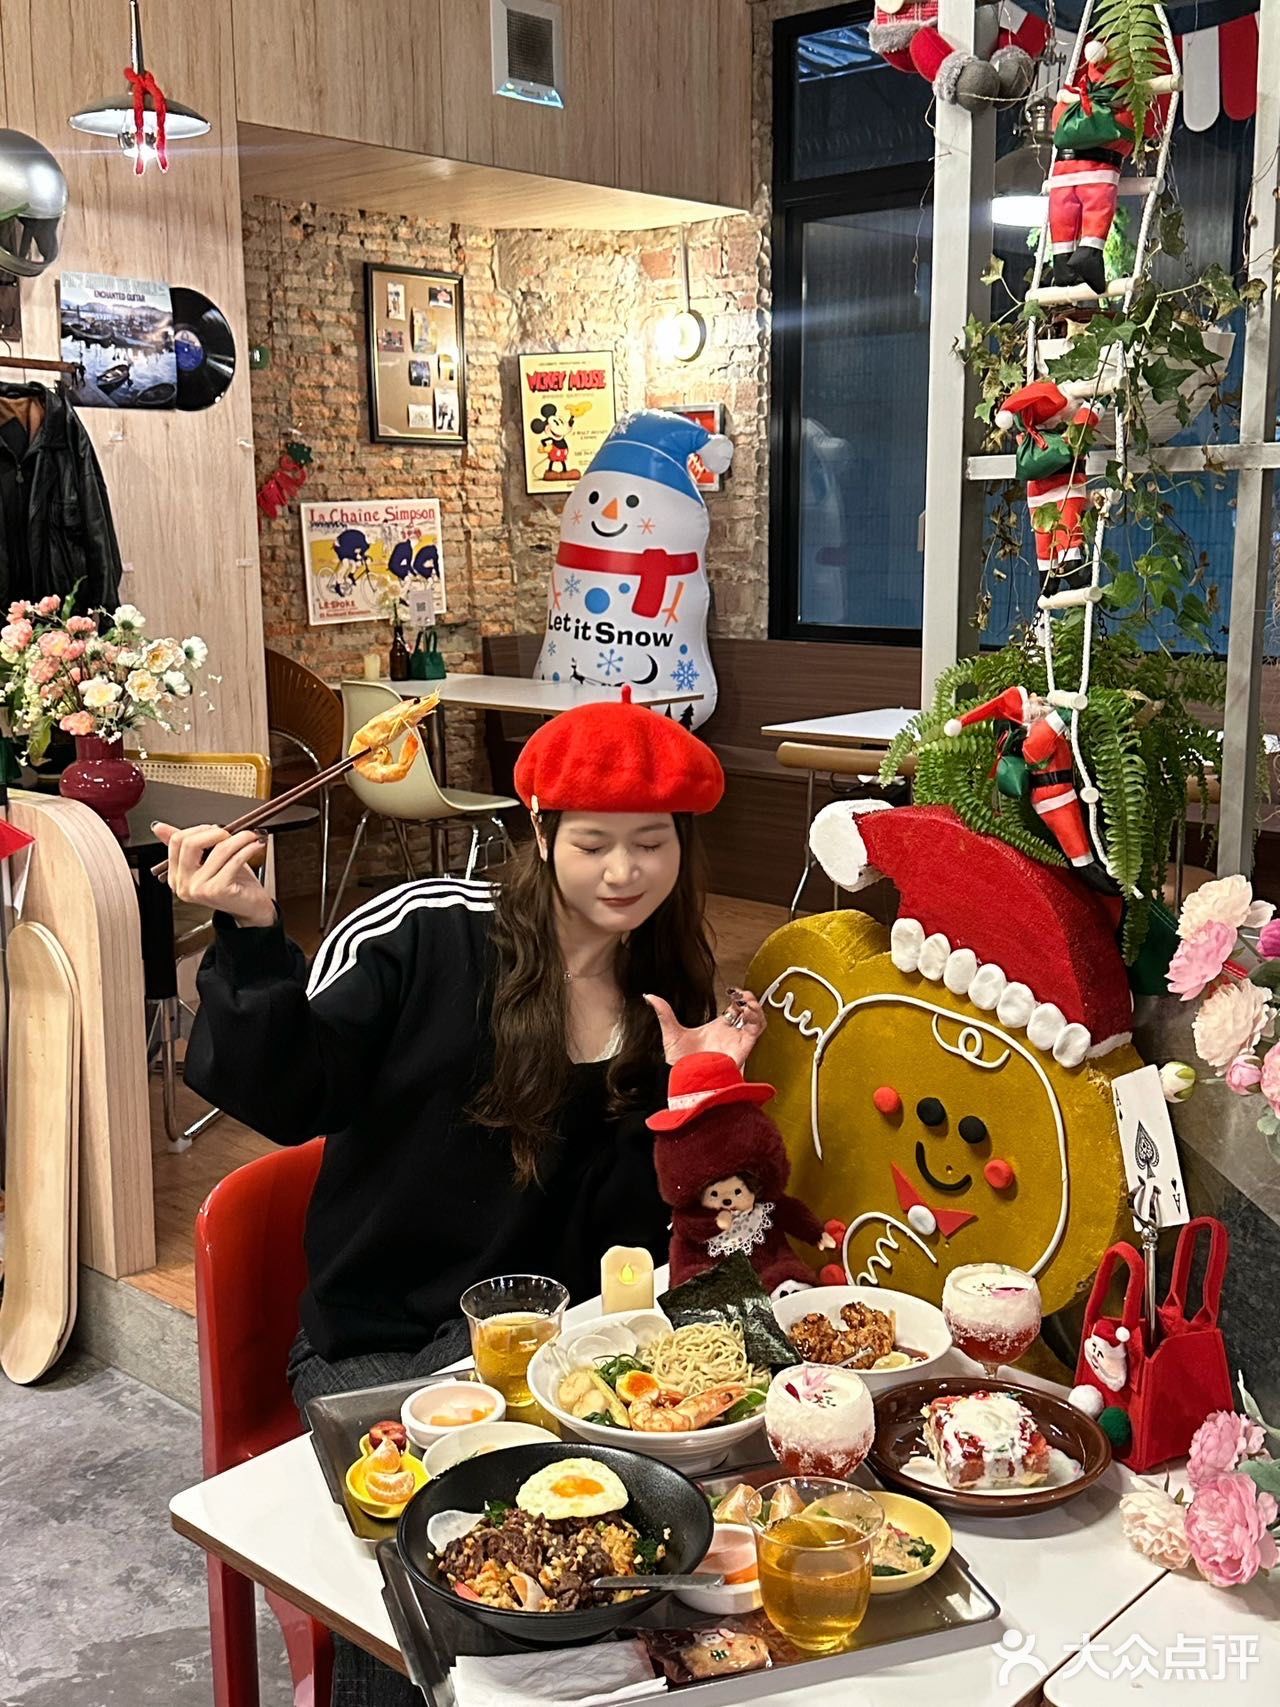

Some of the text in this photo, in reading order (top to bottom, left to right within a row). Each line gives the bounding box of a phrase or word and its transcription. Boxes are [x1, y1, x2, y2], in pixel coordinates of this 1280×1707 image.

[568, 369, 606, 391] MOUSE
[309, 506, 435, 527] La Chaîne Simpson
[548, 609, 674, 647] Let it Snow
